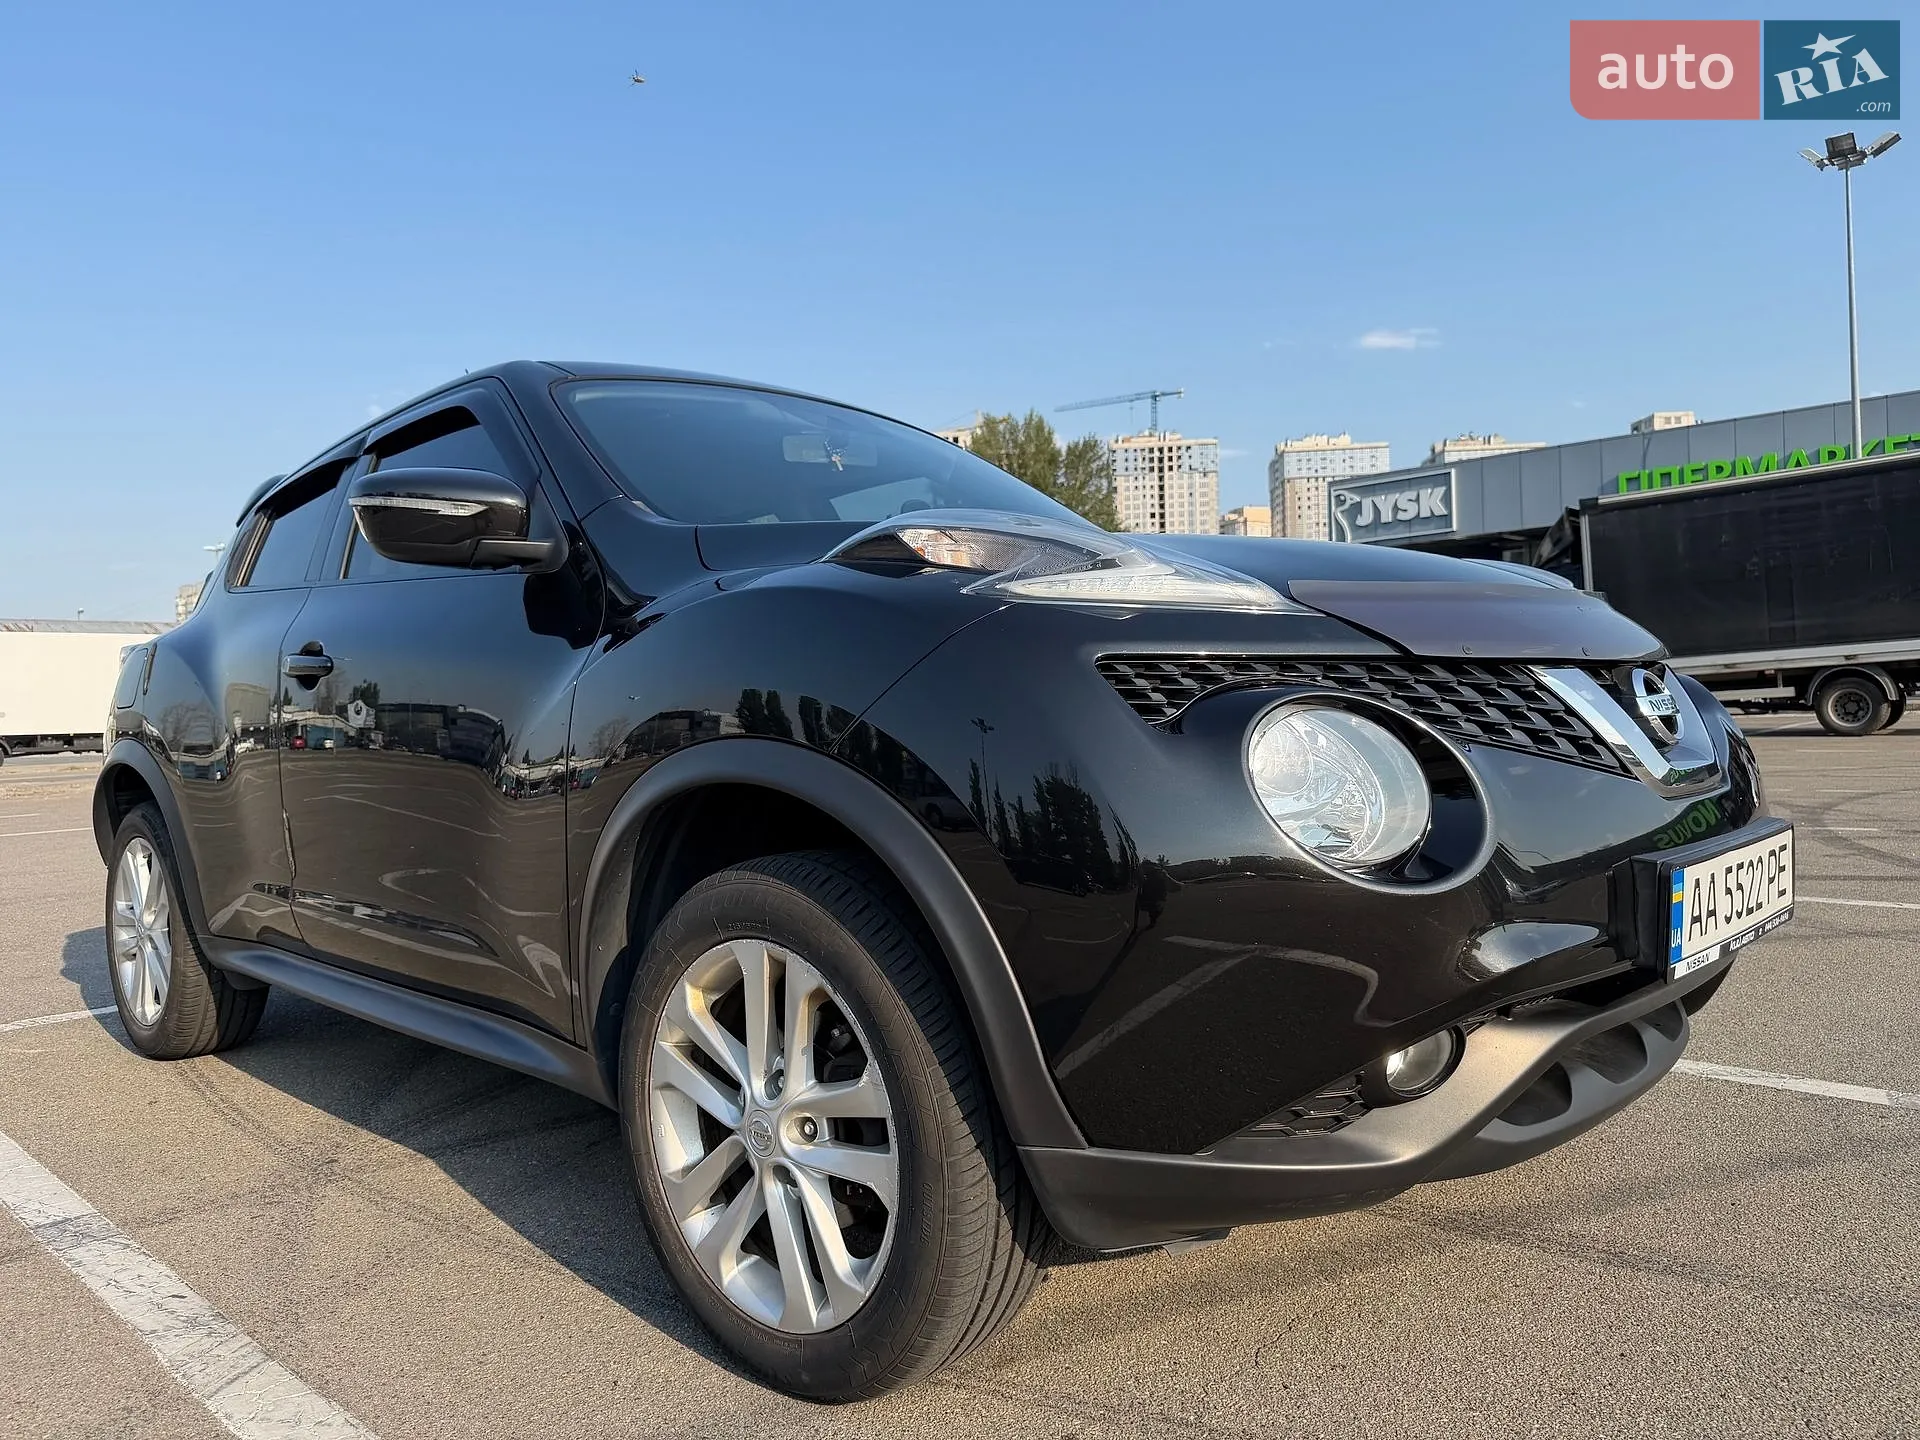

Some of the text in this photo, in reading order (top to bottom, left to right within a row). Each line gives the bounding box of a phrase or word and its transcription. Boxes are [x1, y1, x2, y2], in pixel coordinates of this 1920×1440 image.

[1617, 432, 1920, 495] ГІПЕРМАРЕ
[1355, 486, 1449, 527] JYSK
[1688, 843, 1788, 942] AA 5522 PE
[1671, 928, 1682, 948] UA
[1685, 952, 1711, 972] NISSAN
